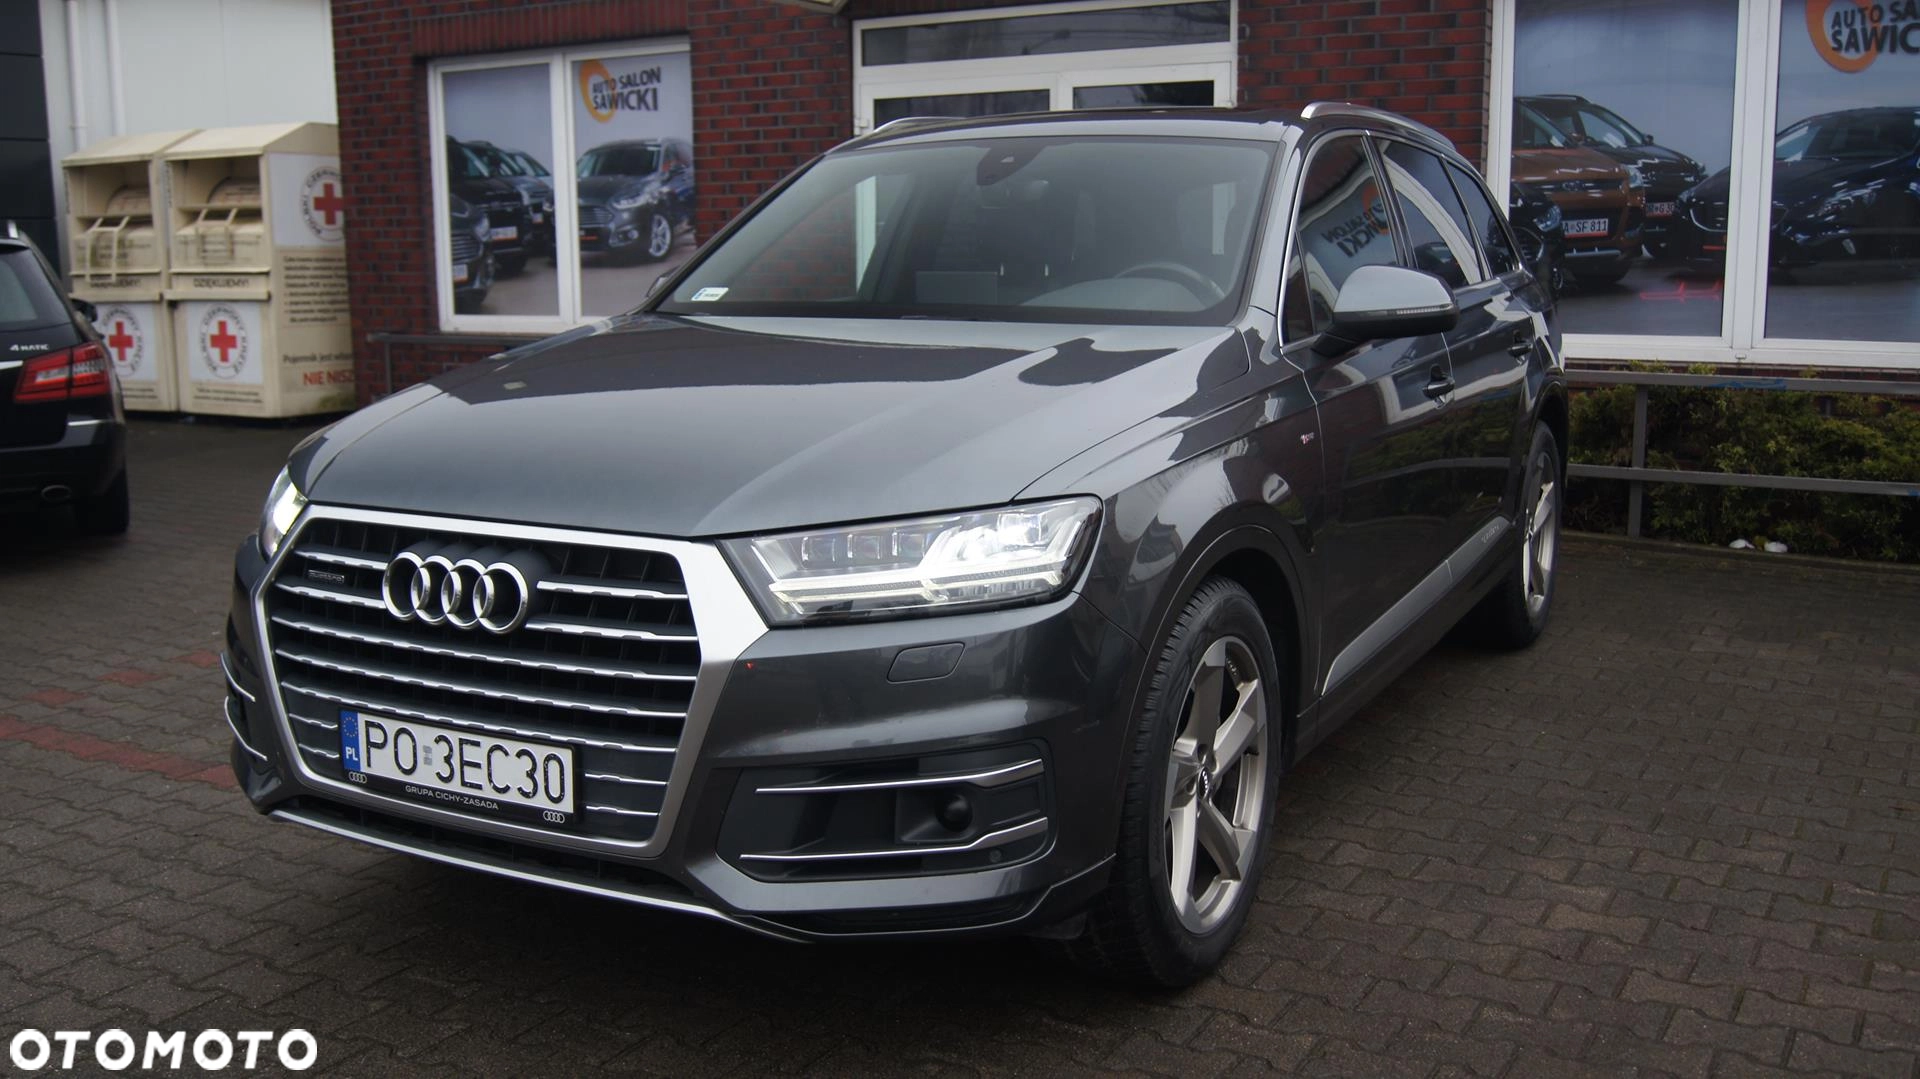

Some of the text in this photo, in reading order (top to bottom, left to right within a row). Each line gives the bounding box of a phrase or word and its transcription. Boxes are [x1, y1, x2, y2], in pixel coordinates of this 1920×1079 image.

[1831, 4, 1883, 30] AUTO
[593, 66, 661, 93] AUTO SALON
[593, 87, 658, 111] SAWICKI
[1576, 220, 1589, 233] SF
[1590, 219, 1607, 232] 811
[303, 370, 325, 386] NIE
[345, 746, 359, 762] PL
[364, 720, 565, 804] PO 3EC30
[405, 784, 500, 810] GRUPA CICHY-ZASADA
